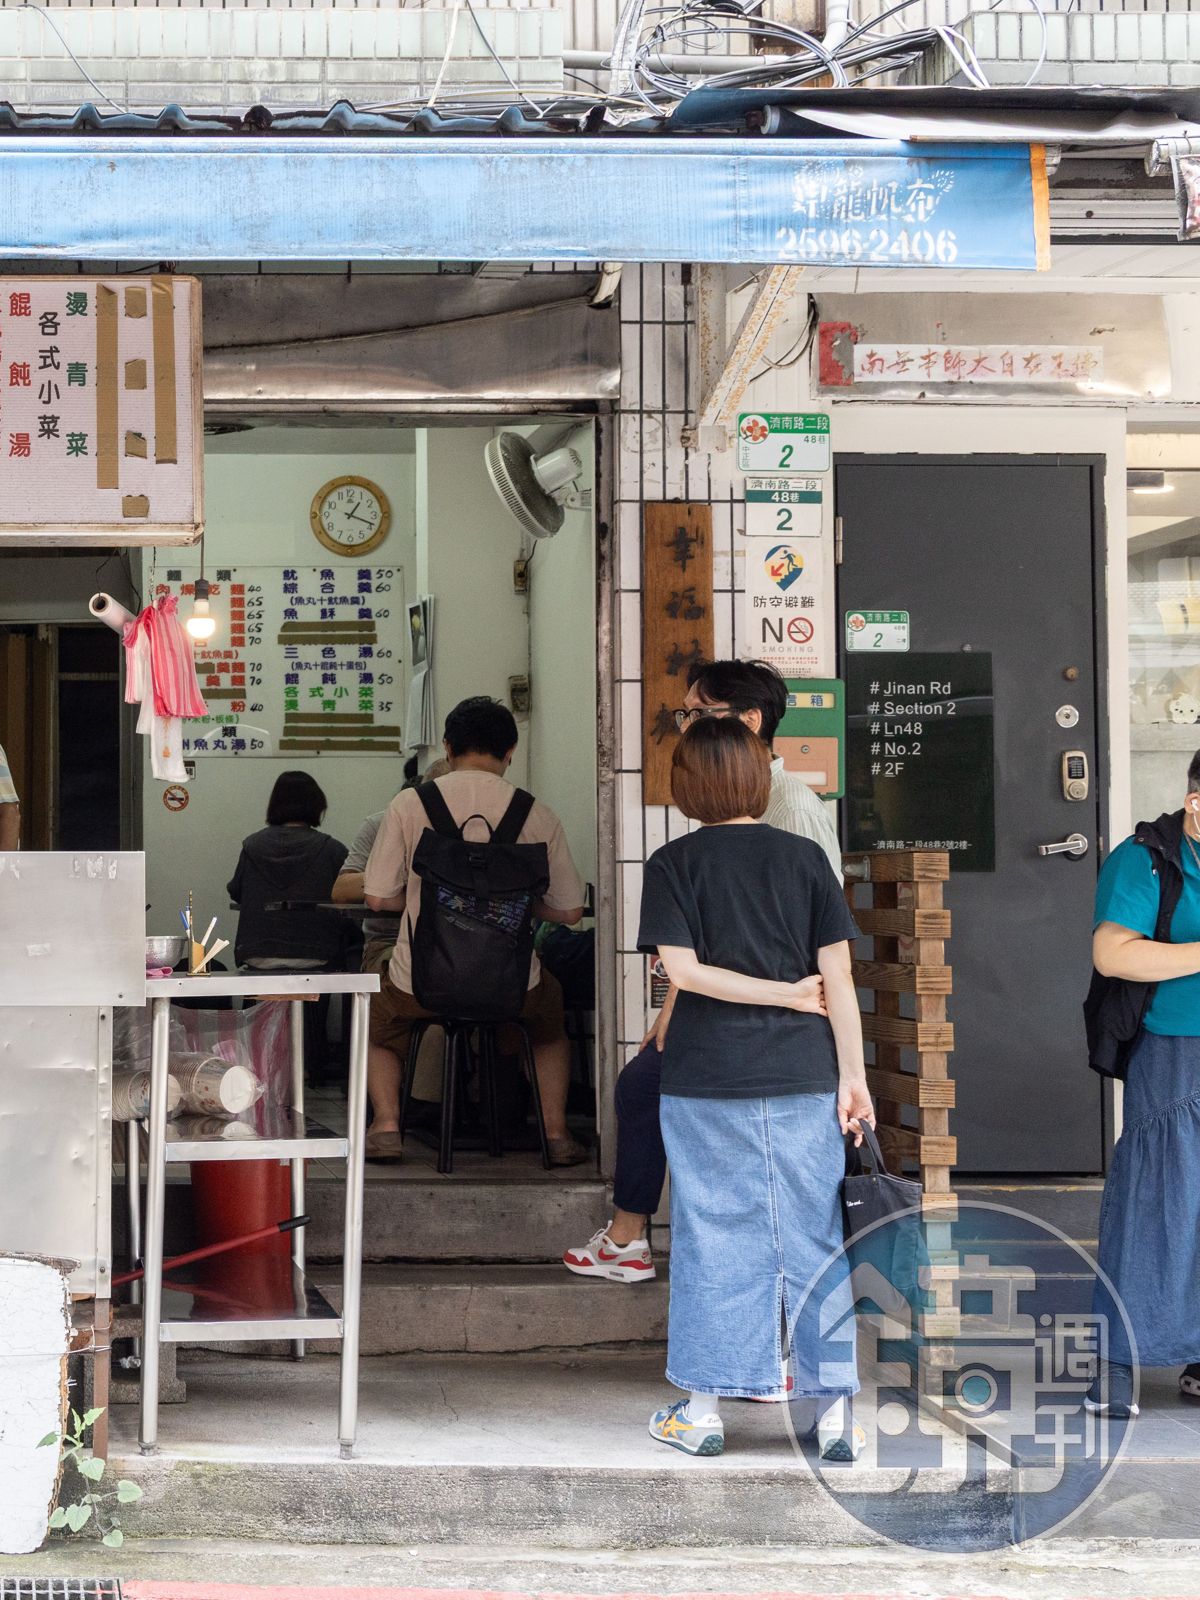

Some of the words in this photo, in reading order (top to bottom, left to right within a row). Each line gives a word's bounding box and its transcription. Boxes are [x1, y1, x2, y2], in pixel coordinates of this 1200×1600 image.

[775, 226, 959, 263] 2596-2406
[9, 292, 32, 458] 餛飩湯
[38, 311, 61, 440] 各式小菜
[65, 291, 89, 458] 燙青菜
[769, 416, 828, 430] 濟南路二段
[778, 444, 794, 468] 2
[751, 480, 817, 490] 濟南路二段
[771, 492, 800, 503] 48巷
[776, 508, 793, 531] 2
[376, 569, 394, 579] 50
[375, 583, 392, 592] 60
[247, 597, 264, 607] 65
[753, 596, 815, 608] 防空避難
[247, 610, 264, 619] 65
[375, 608, 390, 618] 60
[248, 623, 263, 632] 65
[248, 636, 261, 645] 70
[873, 632, 883, 648] 2
[284, 647, 374, 658] 三色湯
[376, 649, 393, 658] 60
[249, 663, 262, 672] 70
[249, 677, 262, 686] 70
[378, 673, 394, 685] 50
[284, 687, 374, 698] 各式小菜
[884, 682, 925, 695] Jinan
[930, 682, 951, 694] Rd
[250, 703, 264, 712] 40
[378, 702, 393, 712] 35
[884, 702, 943, 715] Section
[947, 702, 956, 714] 2
[884, 722, 923, 736] Ln48
[250, 739, 264, 749] 50
[884, 742, 921, 756] No.2
[884, 763, 904, 776] 2F
